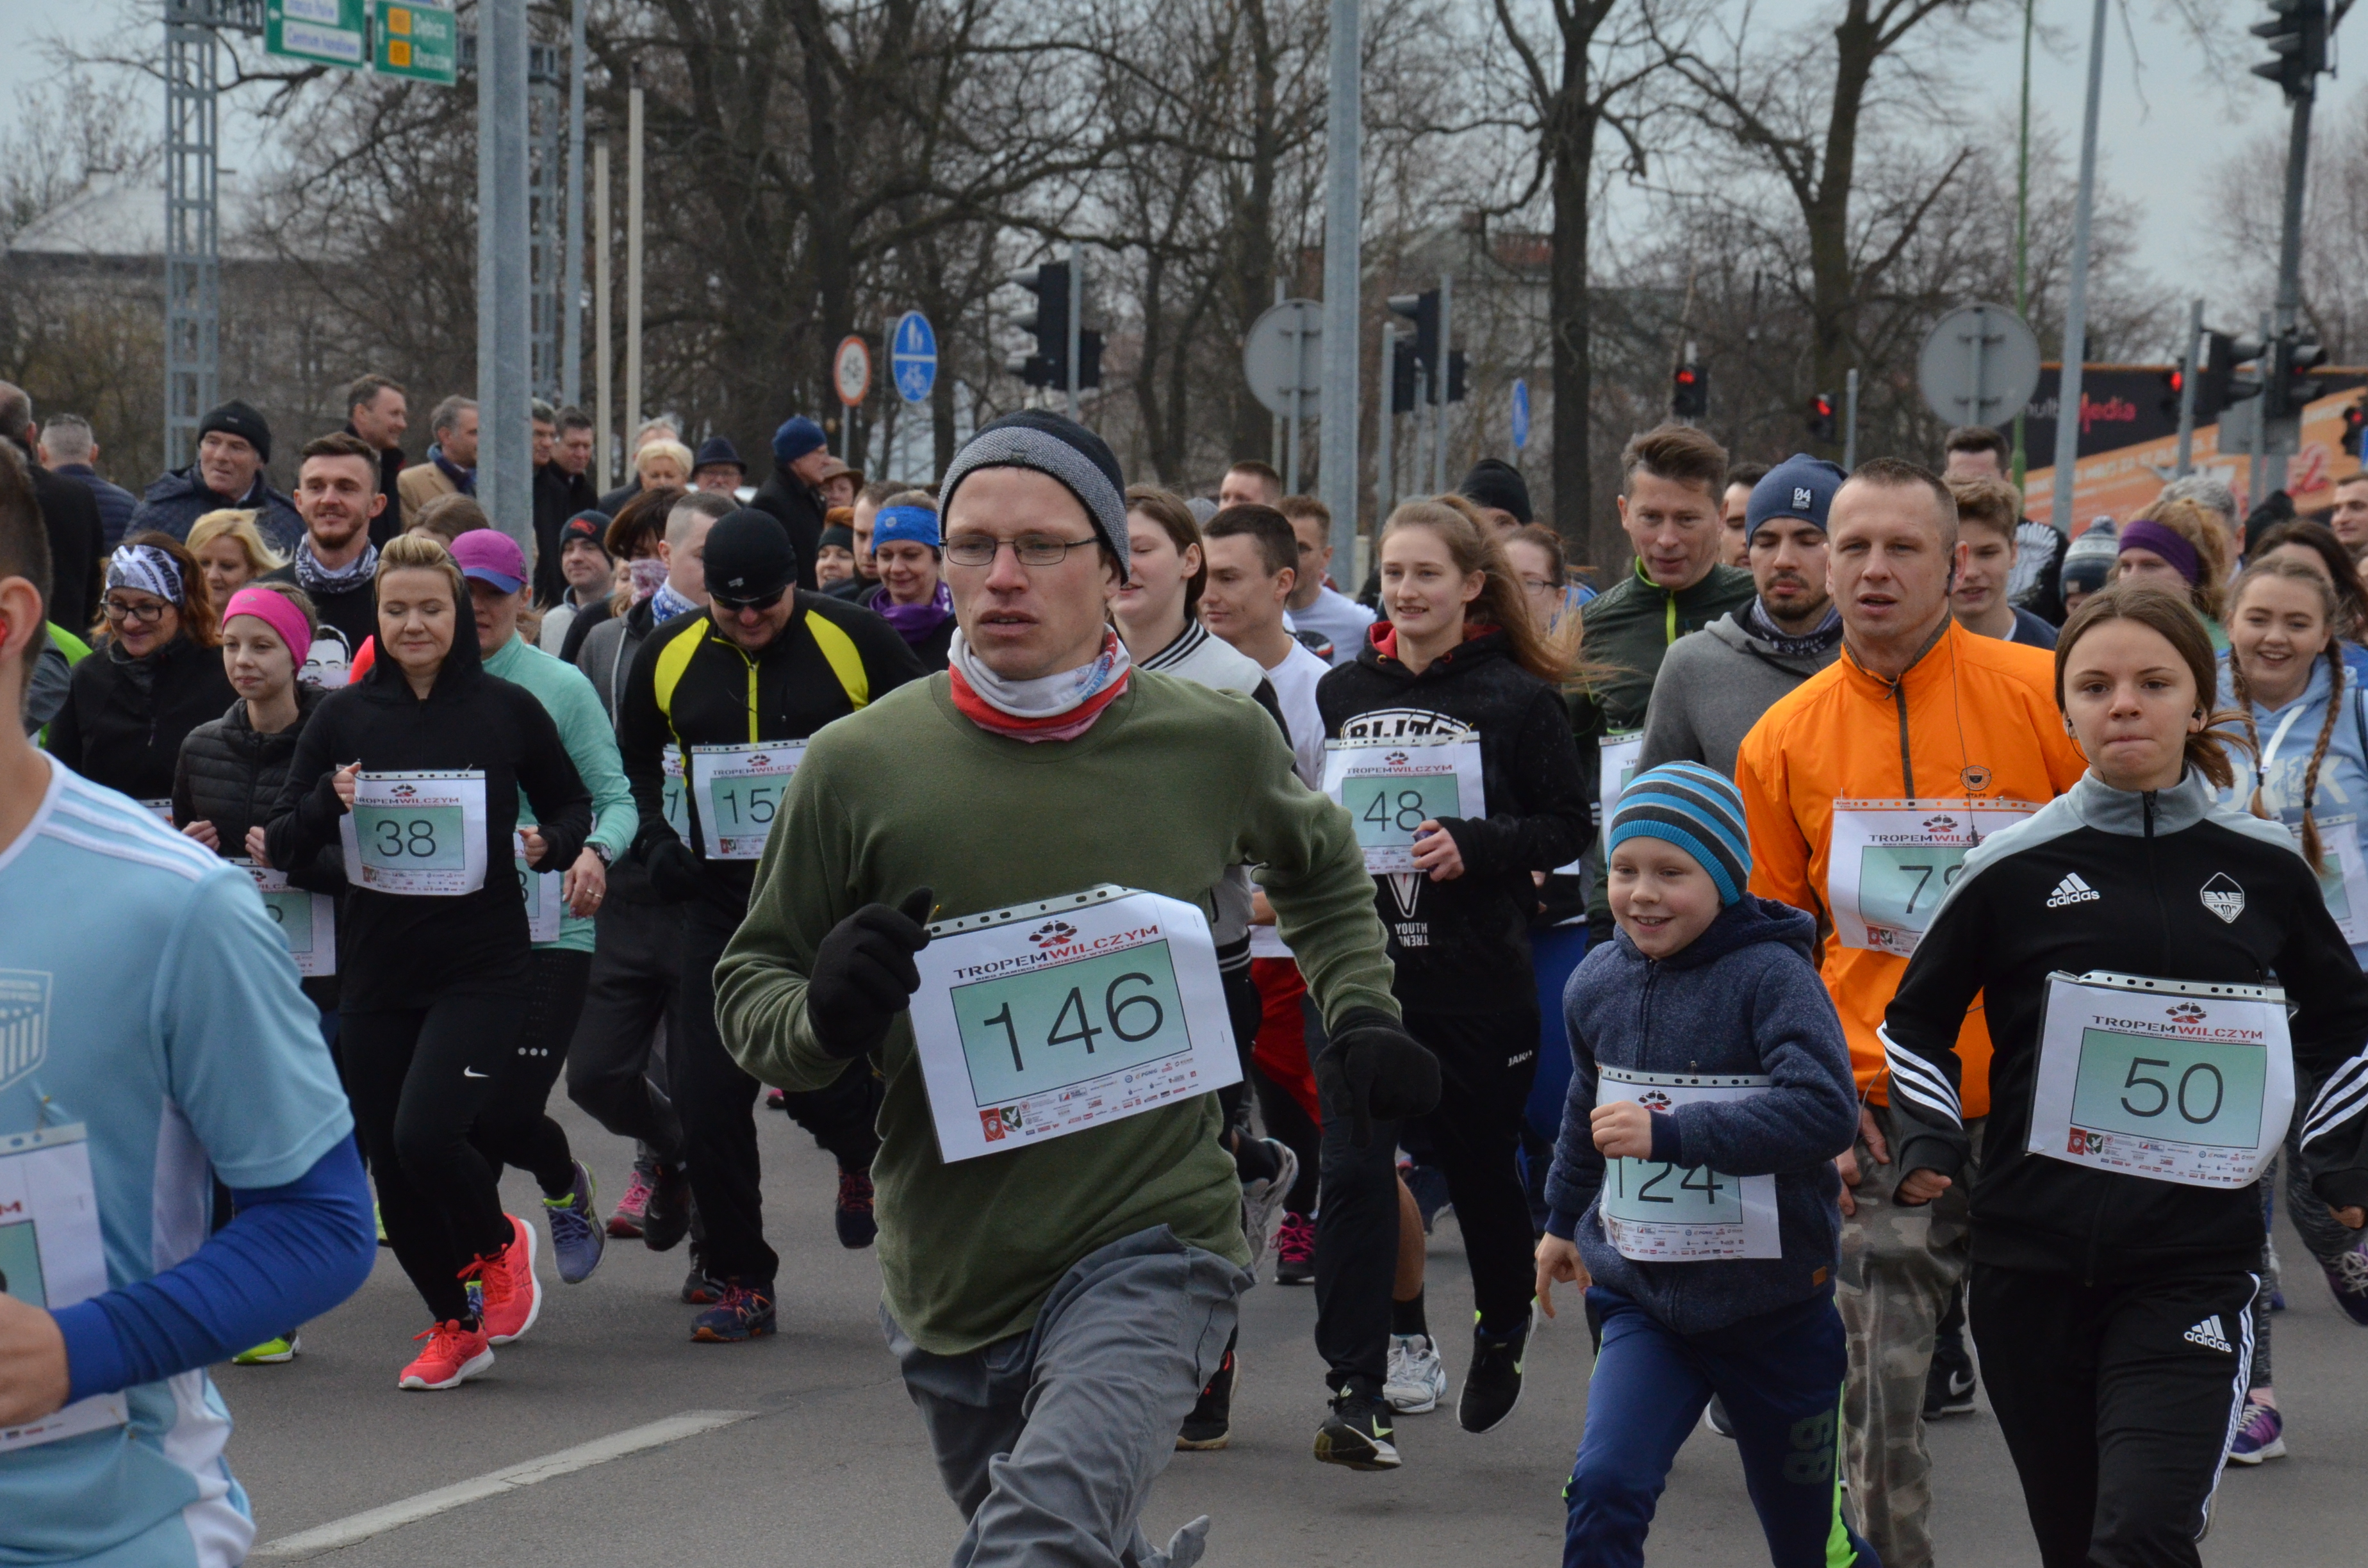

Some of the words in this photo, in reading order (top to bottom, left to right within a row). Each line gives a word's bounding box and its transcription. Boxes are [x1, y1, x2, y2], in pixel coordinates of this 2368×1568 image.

[712, 764, 798, 776] TROPEMWILCZY
[723, 786, 787, 824] 15
[1363, 790, 1426, 832] 48
[375, 819, 436, 858] 38
[2046, 890, 2100, 908] adidas
[1394, 922, 1428, 935] YOUTH
[953, 924, 1159, 979] TROPEMWILCZYM
[983, 972, 1163, 1072] 146
[2091, 1015, 2264, 1040] TROPEMWILCZYM
[2120, 1057, 2224, 1125] 50
[1618, 1155, 1723, 1205] 124
[2183, 1330, 2233, 1353] adidas
